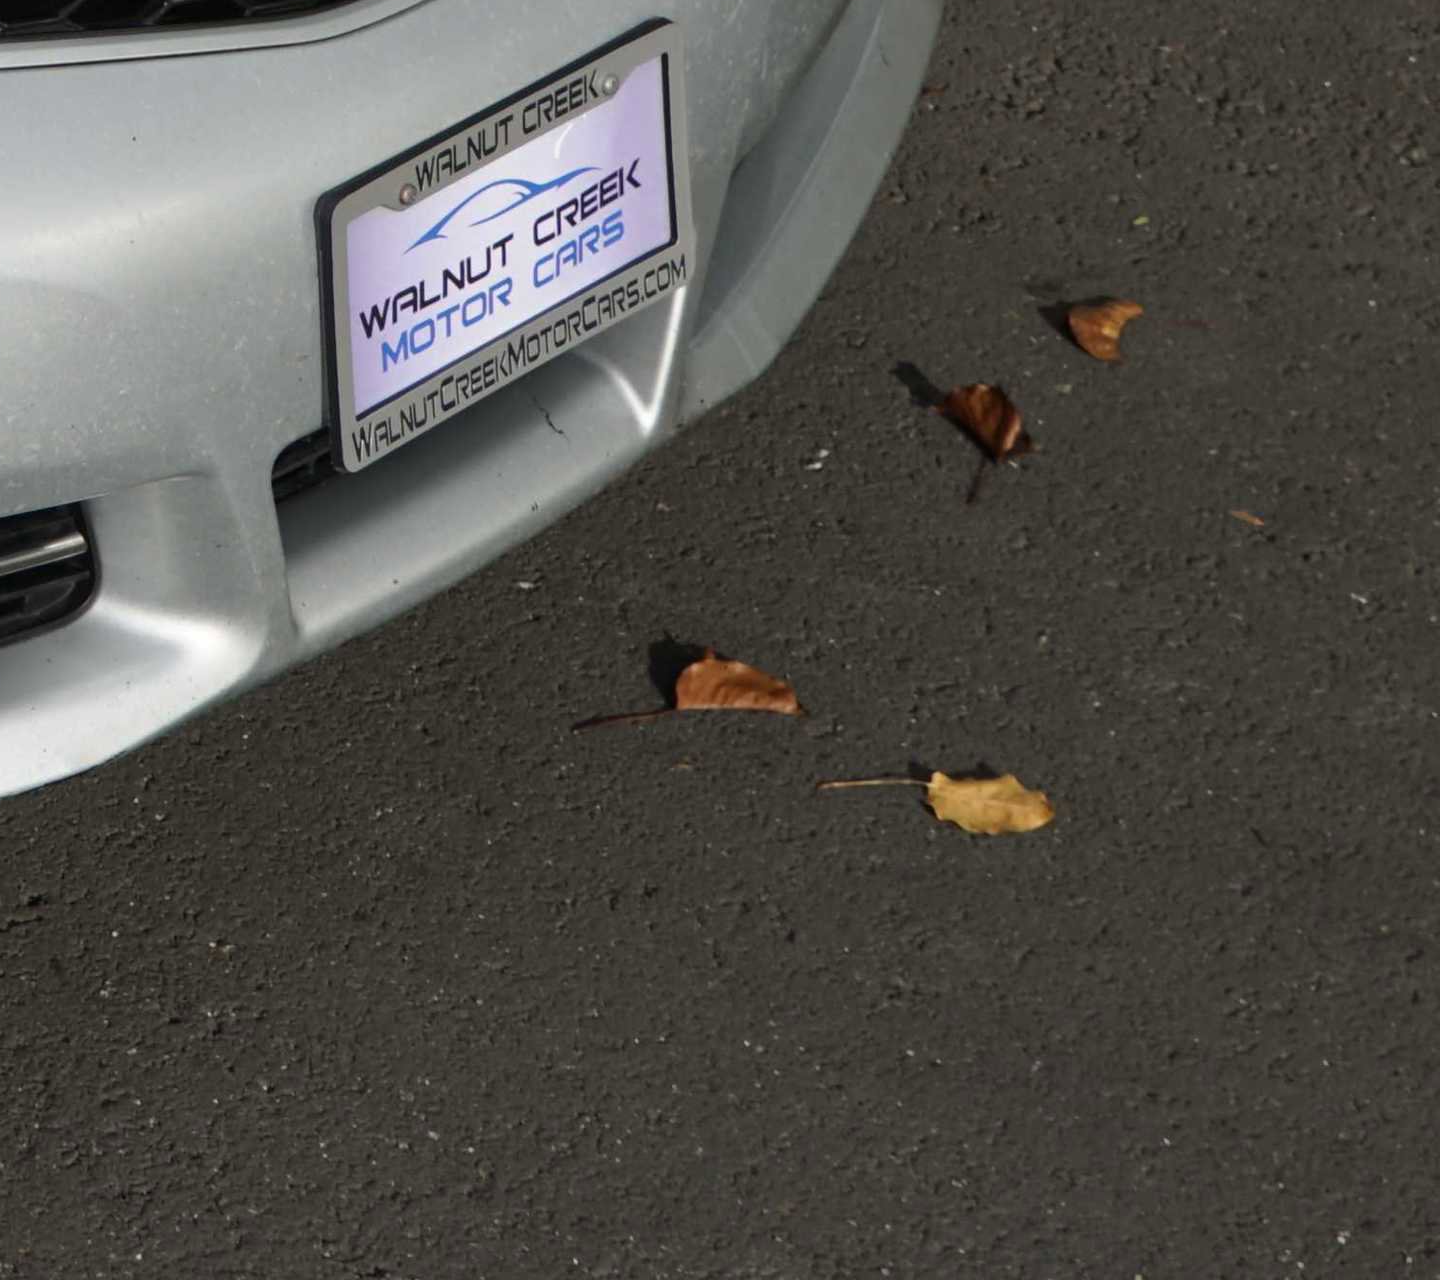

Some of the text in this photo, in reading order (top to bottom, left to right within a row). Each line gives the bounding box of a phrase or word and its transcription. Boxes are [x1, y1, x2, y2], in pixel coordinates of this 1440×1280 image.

[414, 69, 599, 194] WALNUT CREEK
[359, 158, 642, 338] WALNUT CREEK
[380, 209, 625, 373] MOTOR CARS
